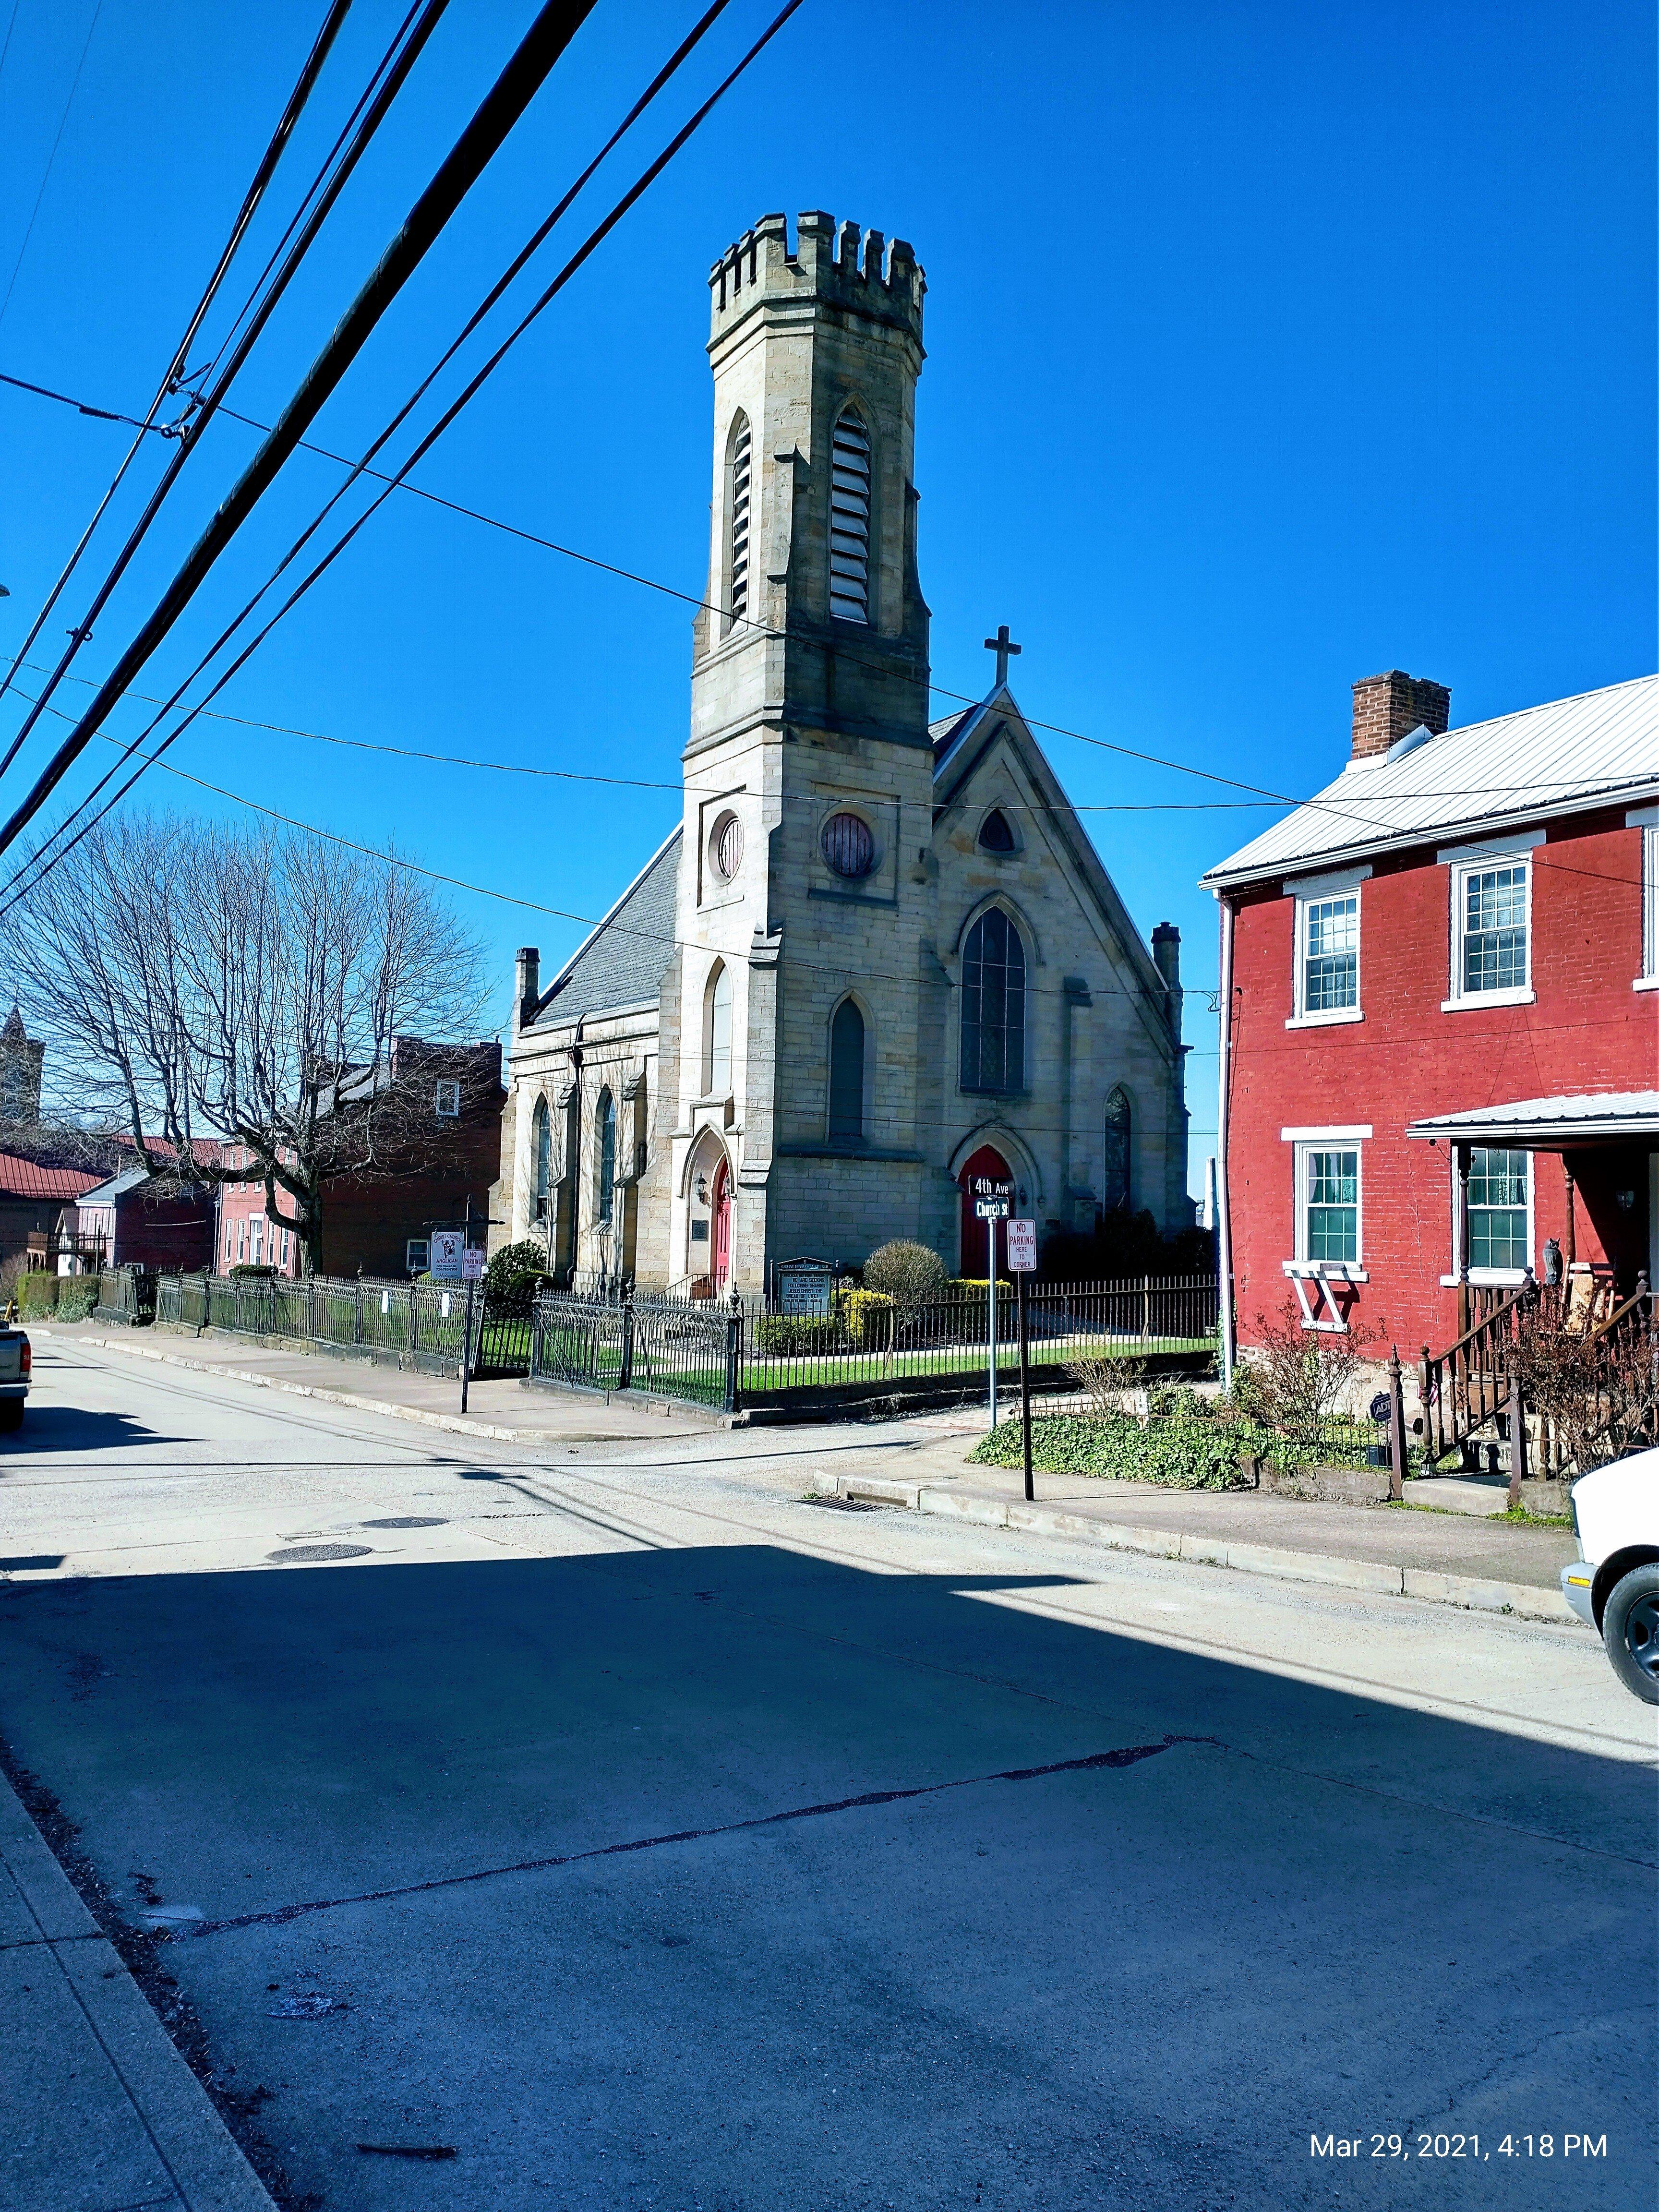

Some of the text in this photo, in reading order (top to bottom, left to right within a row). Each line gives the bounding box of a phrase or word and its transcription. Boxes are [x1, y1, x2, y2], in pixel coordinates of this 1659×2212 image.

[975, 1178, 1009, 1194] 4th Ave
[977, 1201, 1000, 1217] Church
[1016, 1224, 1026, 1233] NO
[433, 1234, 462, 1243] CHRIST CHURCH
[1010, 1236, 1034, 1245] PARKING
[1375, 1400, 1391, 1415] ADT
